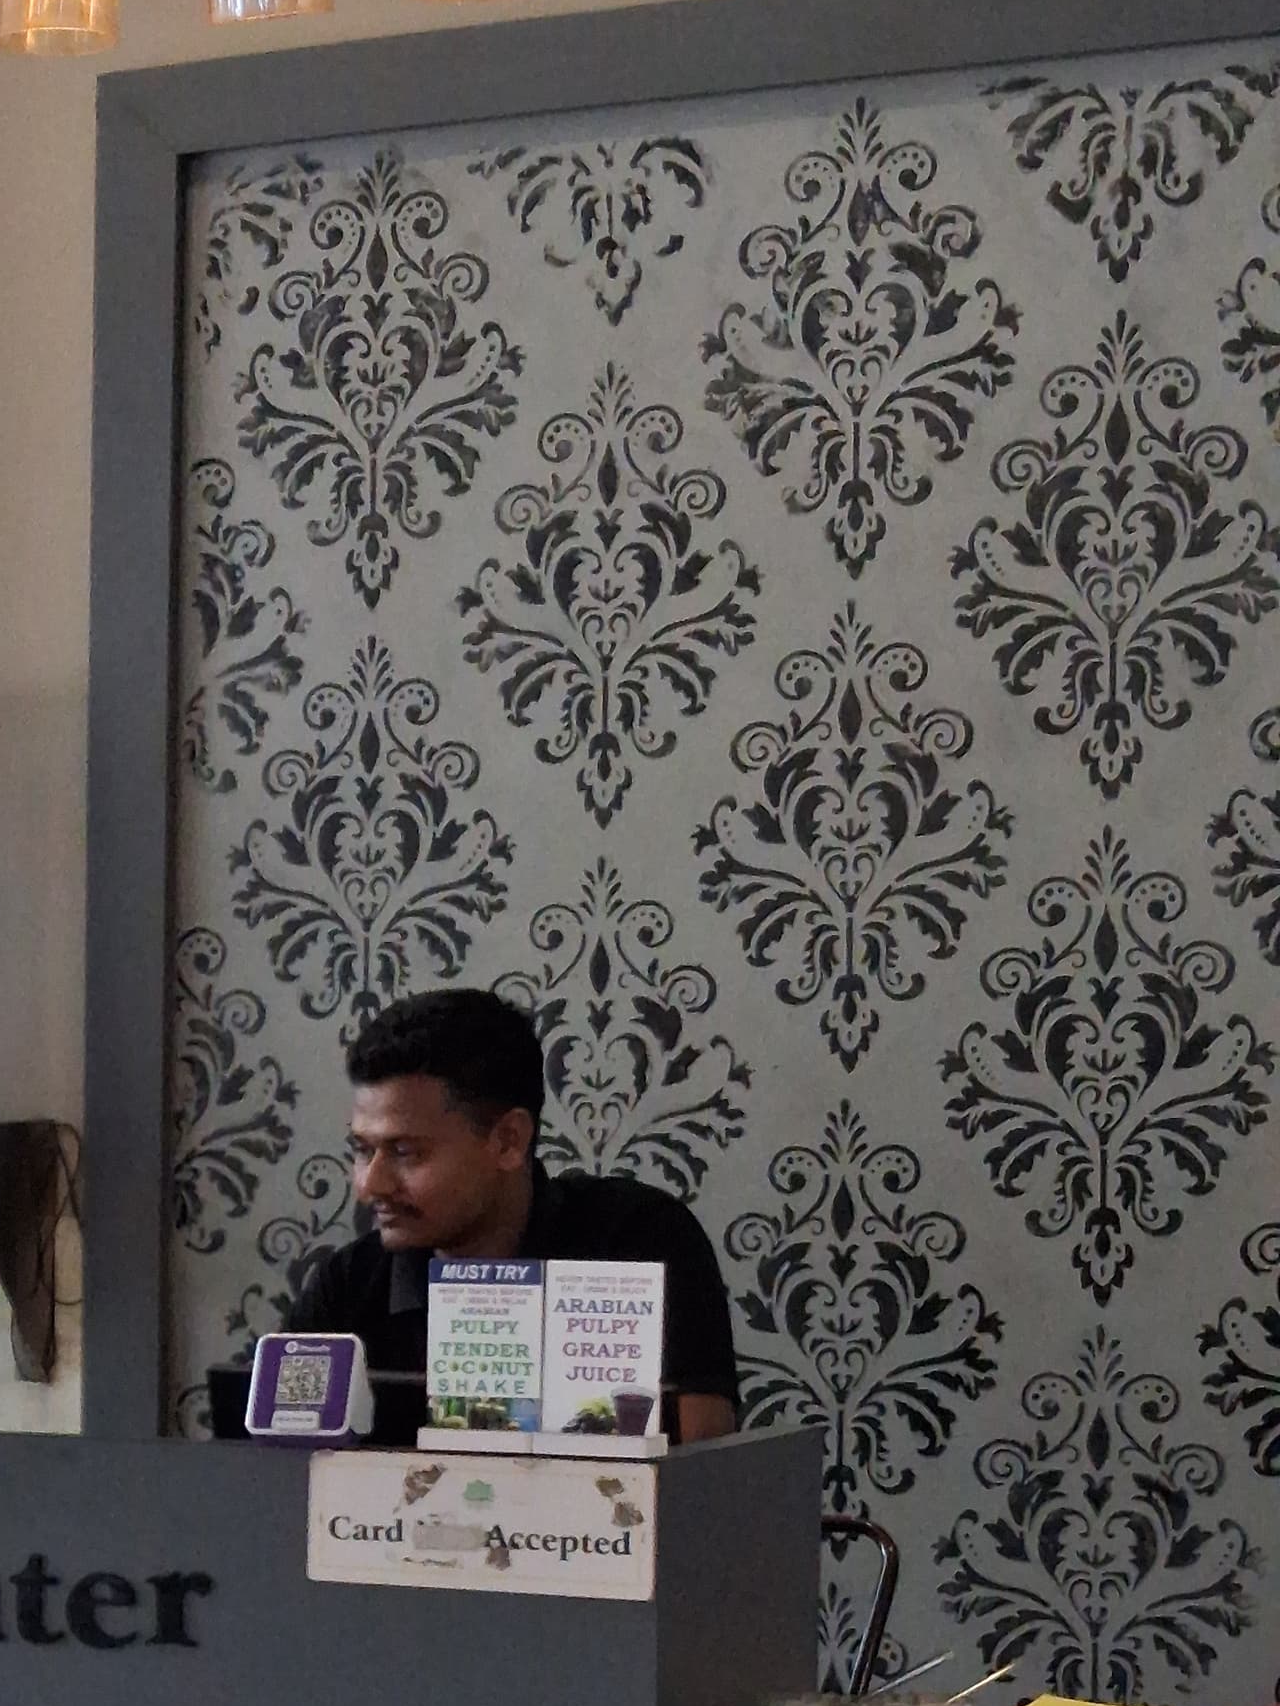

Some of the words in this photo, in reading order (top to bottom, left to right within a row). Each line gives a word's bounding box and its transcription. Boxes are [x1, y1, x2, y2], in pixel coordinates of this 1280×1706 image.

[441, 1264, 489, 1279] MUST
[495, 1265, 530, 1280] TRY
[553, 1298, 654, 1315] ARABIAN
[451, 1320, 519, 1335] PULPY
[566, 1318, 639, 1335] PULPY
[439, 1342, 529, 1358] TENDER
[563, 1342, 642, 1359] GRAPE
[566, 1366, 637, 1383] JUICE
[438, 1379, 526, 1394] SHAKE
[328, 1516, 404, 1543] Card
[484, 1525, 632, 1562] Accepted
